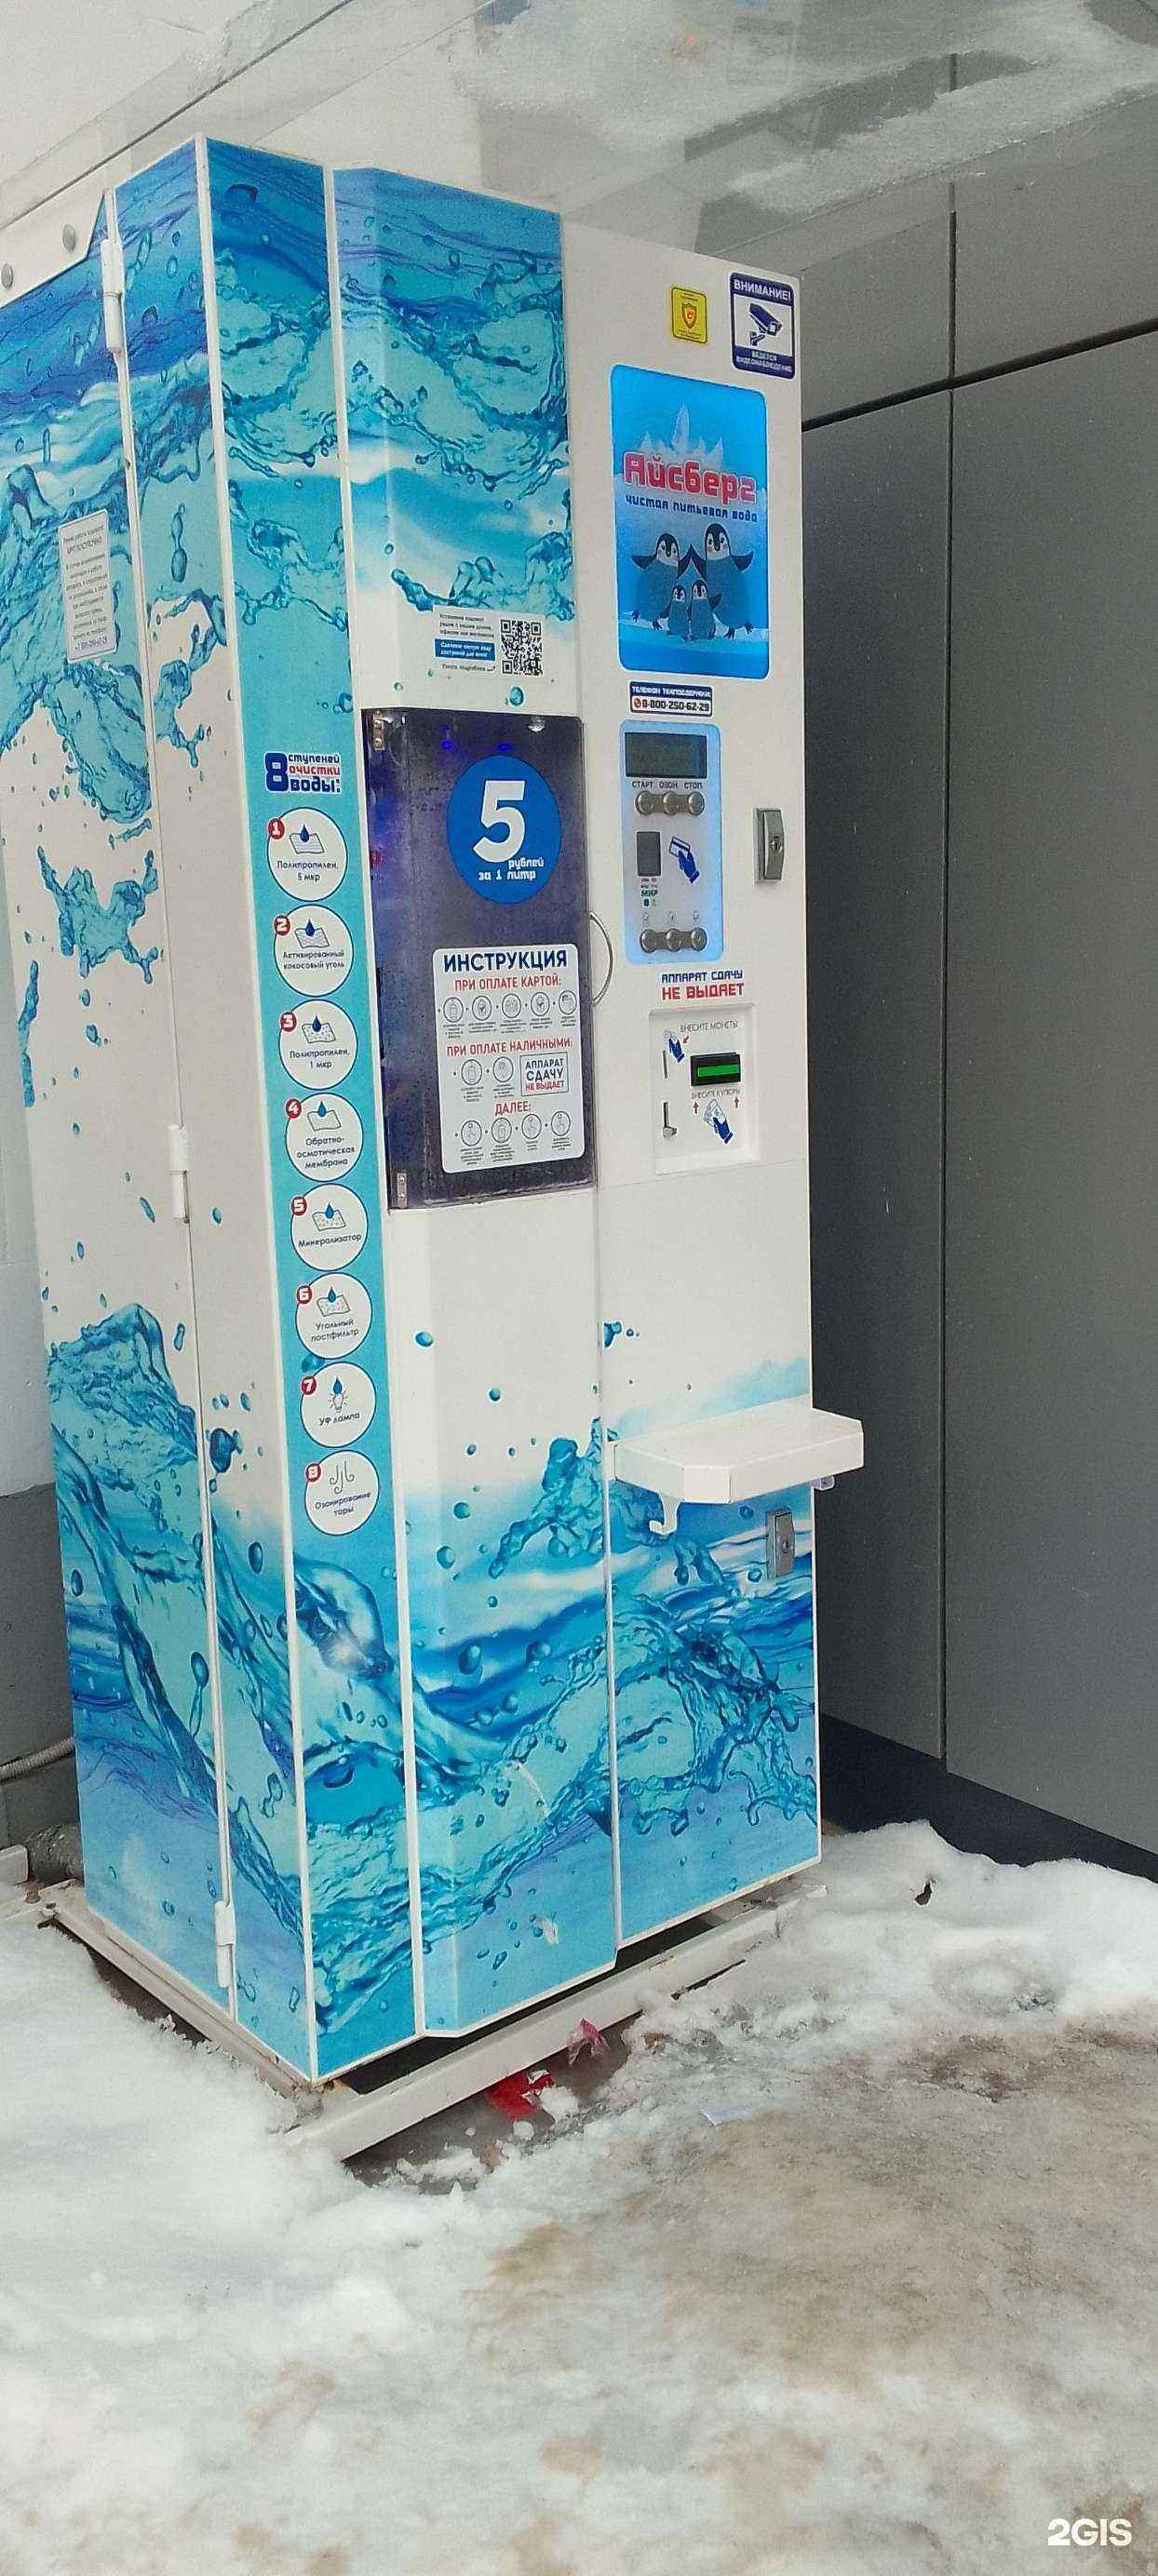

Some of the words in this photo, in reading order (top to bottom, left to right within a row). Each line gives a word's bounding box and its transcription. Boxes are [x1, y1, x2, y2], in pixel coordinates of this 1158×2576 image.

[734, 278, 791, 302] ВНИМАНИЕ!
[625, 452, 757, 505] Айсберг
[626, 494, 668, 510] чистая
[673, 502, 728, 518] питьевая
[732, 509, 758, 522] вода
[632, 686, 660, 694] ТЕЛЕФОН
[642, 699, 709, 712] 8-800-250-62-29
[265, 752, 289, 791] 8
[289, 753, 340, 764] ступеней
[289, 765, 341, 775] очистки
[290, 776, 341, 793] воды:
[473, 780, 526, 863] 5
[272, 823, 281, 836] 1
[277, 861, 339, 869] Полипропилен,
[507, 857, 545, 870] рублей
[303, 874, 321, 882] мкр
[478, 871, 491, 880] за
[495, 869, 503, 880] 1
[506, 869, 536, 880] литр
[277, 918, 288, 932] 2
[283, 949, 344, 959] Активированный
[284, 961, 324, 970] кокосовый
[326, 962, 344, 971] уголь
[443, 949, 567, 973] ИНСТРУКЦИЯ
[454, 979, 476, 991] ПРИ
[479, 977, 518, 990] ОПЛАТЕ
[521, 973, 561, 987] КАРТОЙ:
[661, 972, 707, 984] АППАРАТ
[711, 969, 743, 981] СДАЧУ
[662, 986, 680, 1000] НЕ
[686, 983, 745, 999] ВЫДАЕТ
[284, 1015, 294, 1028] 3
[290, 1049, 350, 1059] Полипропилен,
[447, 1045, 465, 1057] ПРИ
[469, 1042, 506, 1054] ОПЛАТЕ
[509, 1038, 572, 1053] НАЛИЧНЫМИ:
[316, 1061, 332, 1070] мкр
[525, 1058, 563, 1070] АППАРАТ
[526, 1069, 563, 1082] СДАЧУ
[525, 1083, 536, 1092] НЕ
[537, 1080, 564, 1091] ВЫДАЕТ
[289, 1101, 300, 1115] 4
[495, 1101, 532, 1116] ДАЛЕЕ:
[305, 1136, 345, 1147] Обратно-
[297, 1147, 355, 1159] осмотическая
[304, 1158, 348, 1169] мембрана
[294, 1199, 304, 1213] 5
[298, 1234, 362, 1248] Минерализатор
[299, 1290, 309, 1302] 6
[316, 1319, 354, 1331] Угольный
[311, 1328, 359, 1342] постфильтр
[303, 1379, 314, 1392] 7
[318, 1415, 333, 1427] УФ
[333, 1412, 360, 1423] лампа
[308, 1466, 318, 1479] 8
[315, 1492, 371, 1509] Озонирование
